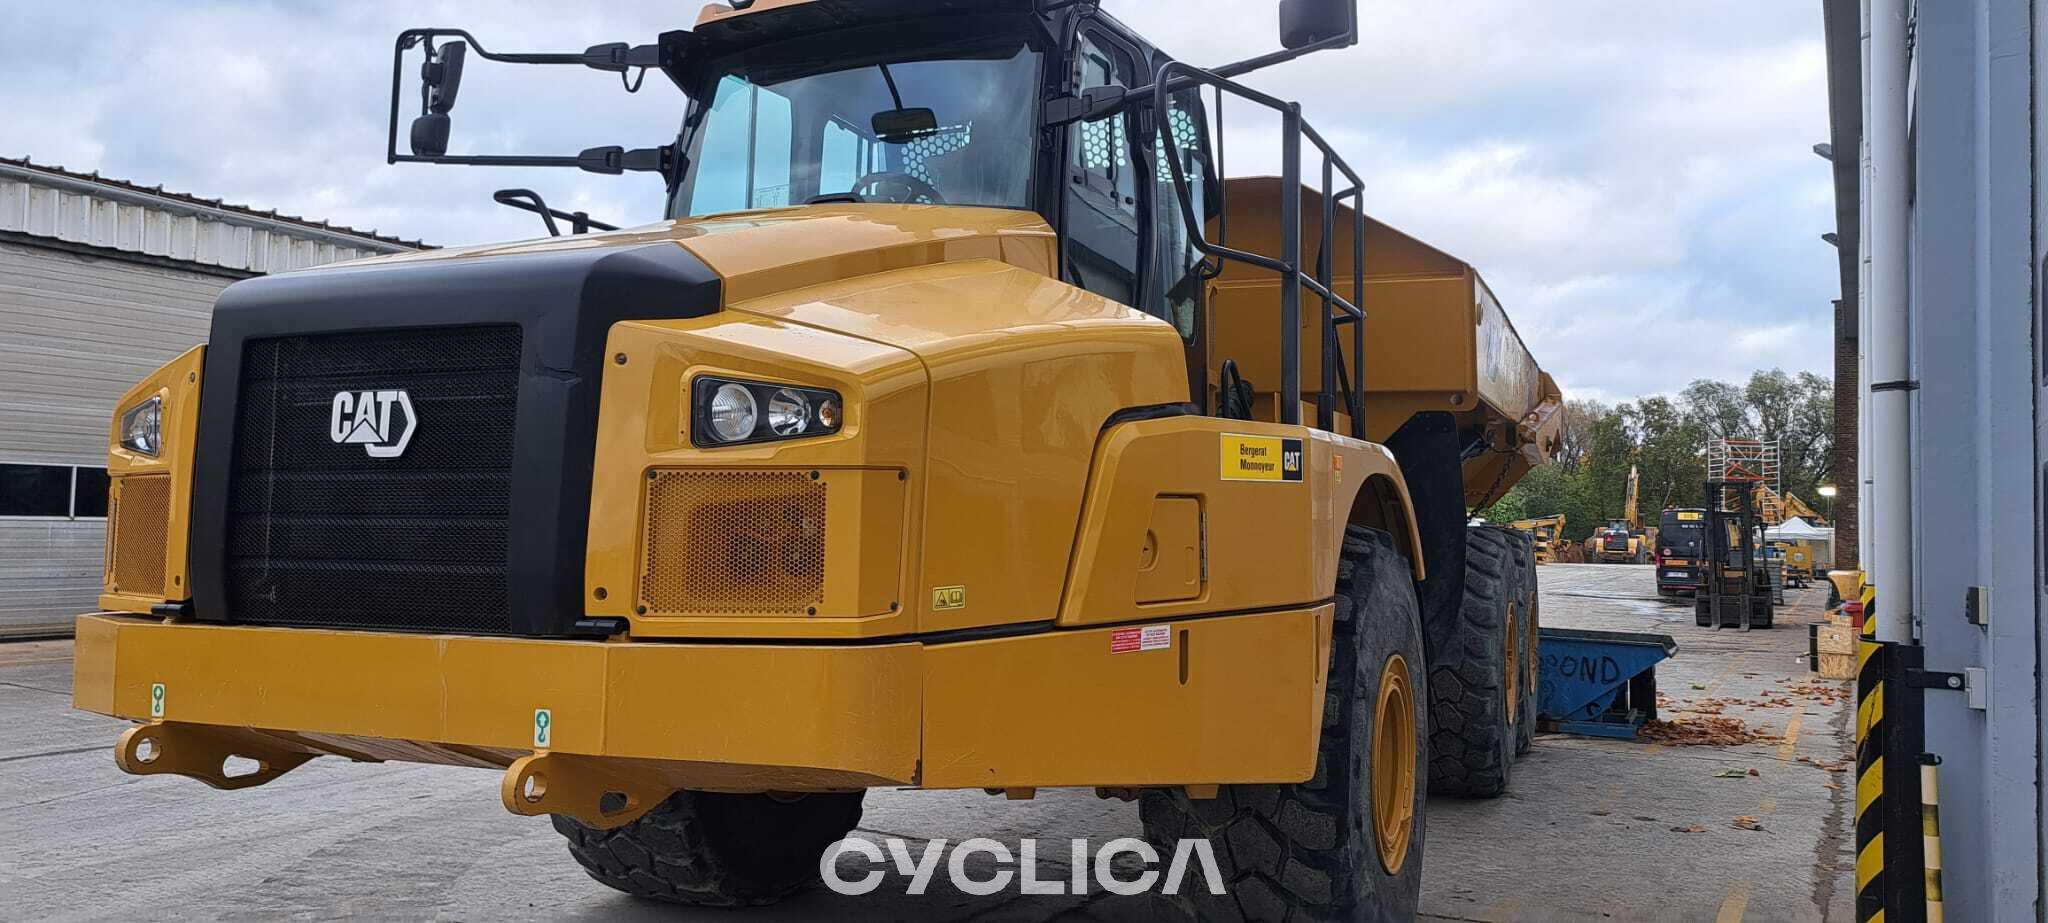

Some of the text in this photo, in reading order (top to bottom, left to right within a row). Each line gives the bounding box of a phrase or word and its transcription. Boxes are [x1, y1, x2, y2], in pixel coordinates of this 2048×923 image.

[331, 390, 398, 443] CAT
[1240, 443, 1268, 458] Bergerat
[1240, 458, 1275, 474] Monnoyeur
[1284, 450, 1301, 472] CAT
